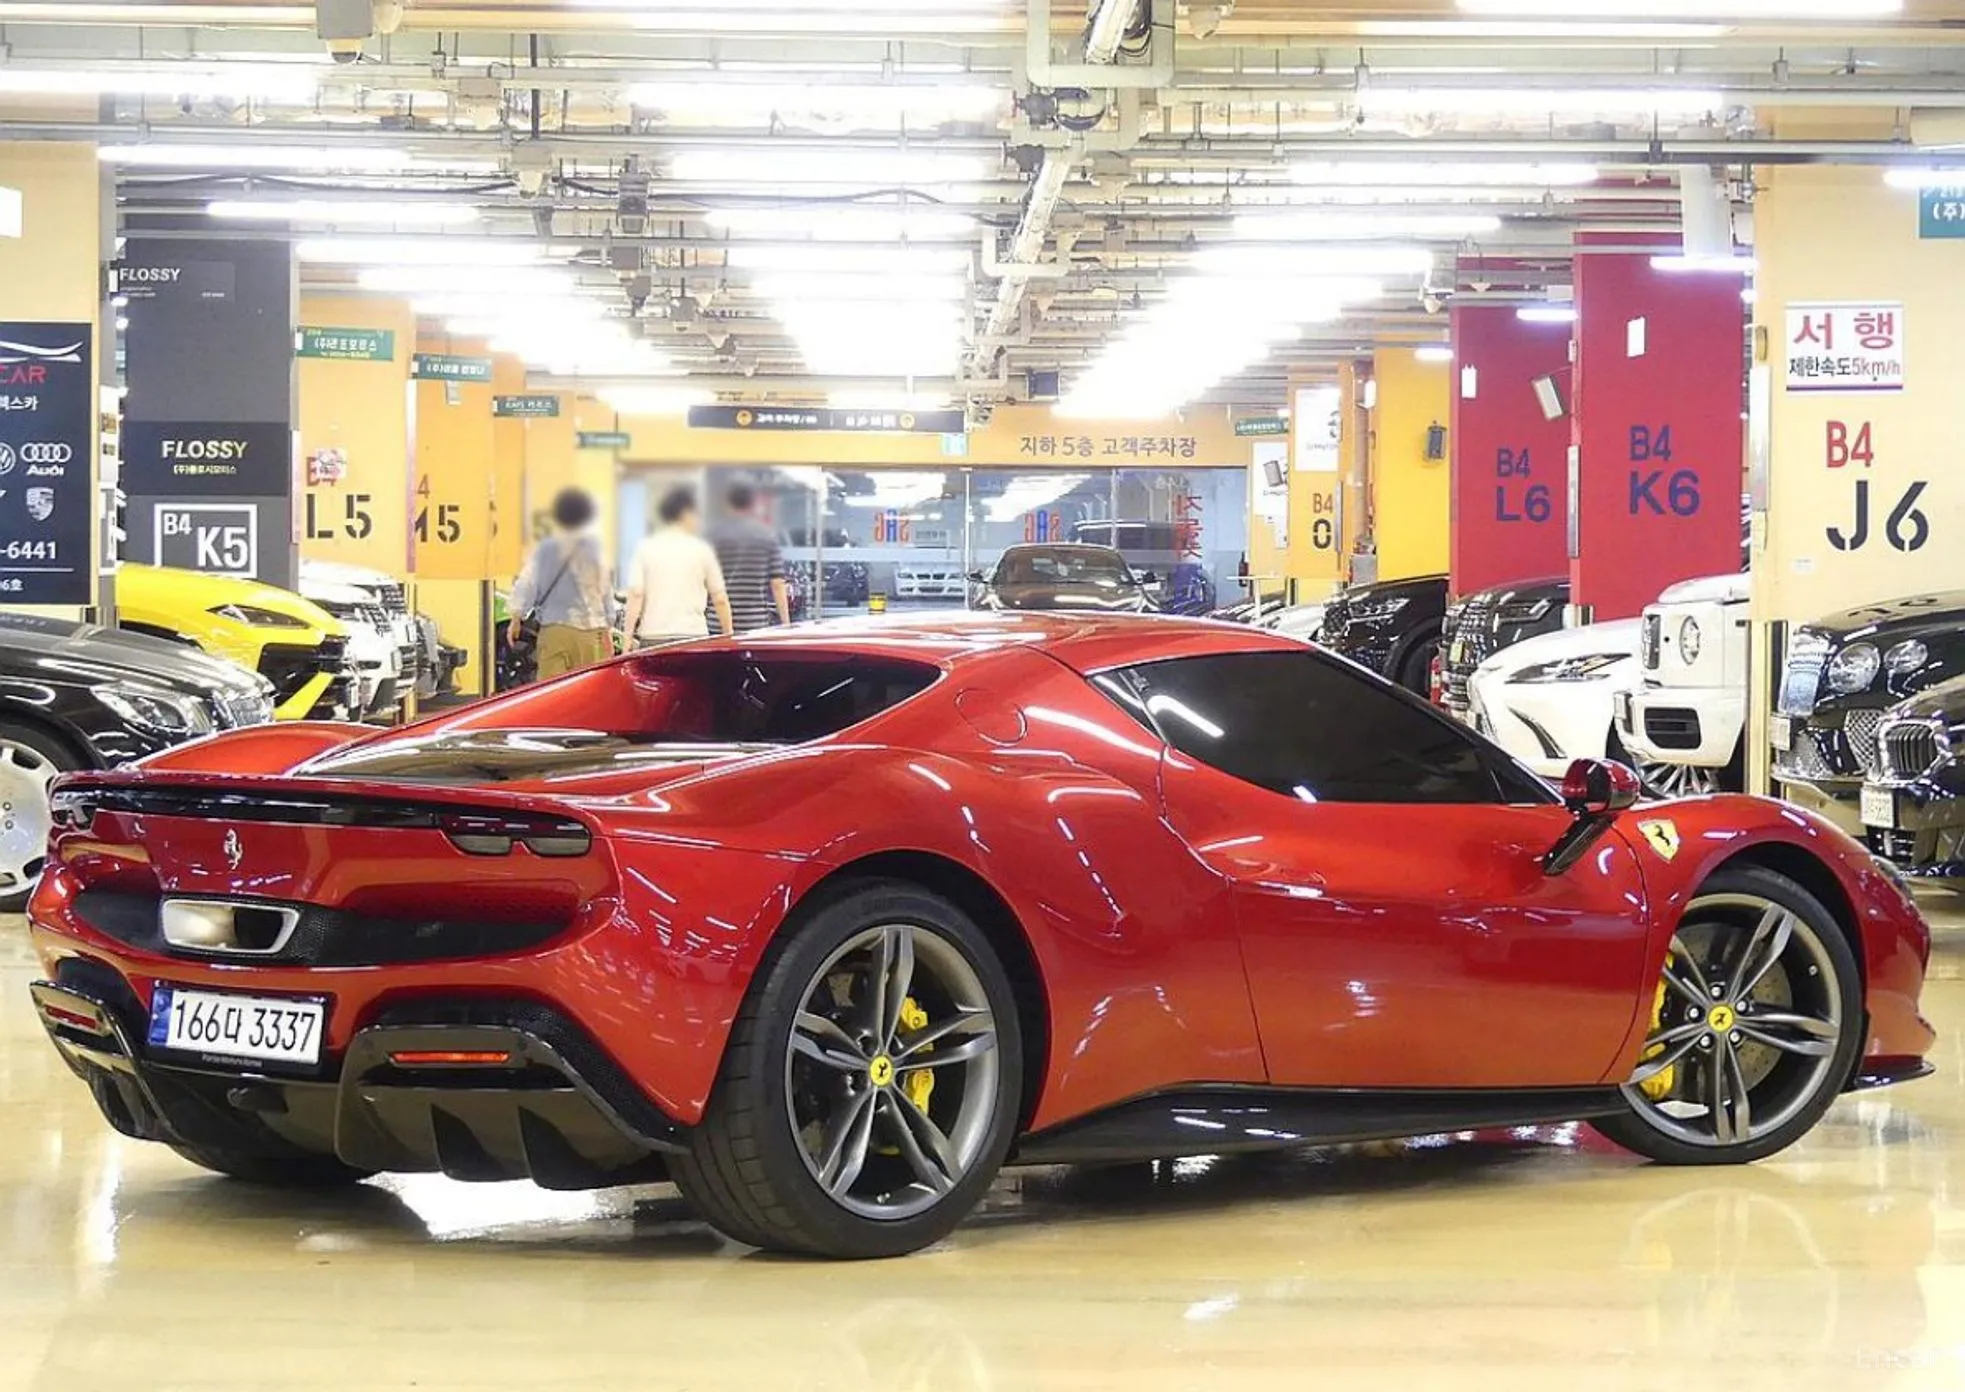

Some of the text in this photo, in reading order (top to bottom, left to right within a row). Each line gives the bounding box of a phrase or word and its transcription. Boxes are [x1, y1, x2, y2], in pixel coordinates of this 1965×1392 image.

[119, 267, 181, 282] FLOSSY
[161, 440, 249, 459] FLOSSY
[1101, 435, 1198, 458] 고객주차장
[1629, 424, 1672, 462] B4
[1825, 420, 1875, 468] B4
[26, 464, 65, 476] Audi
[1496, 447, 1531, 478] B4
[1312, 493, 1334, 514] B4
[1495, 484, 1553, 523] L6
[1628, 469, 1701, 517] K6
[163, 512, 193, 536] B4
[197, 526, 249, 569] K5
[249, 1007, 317, 1053] 3337
